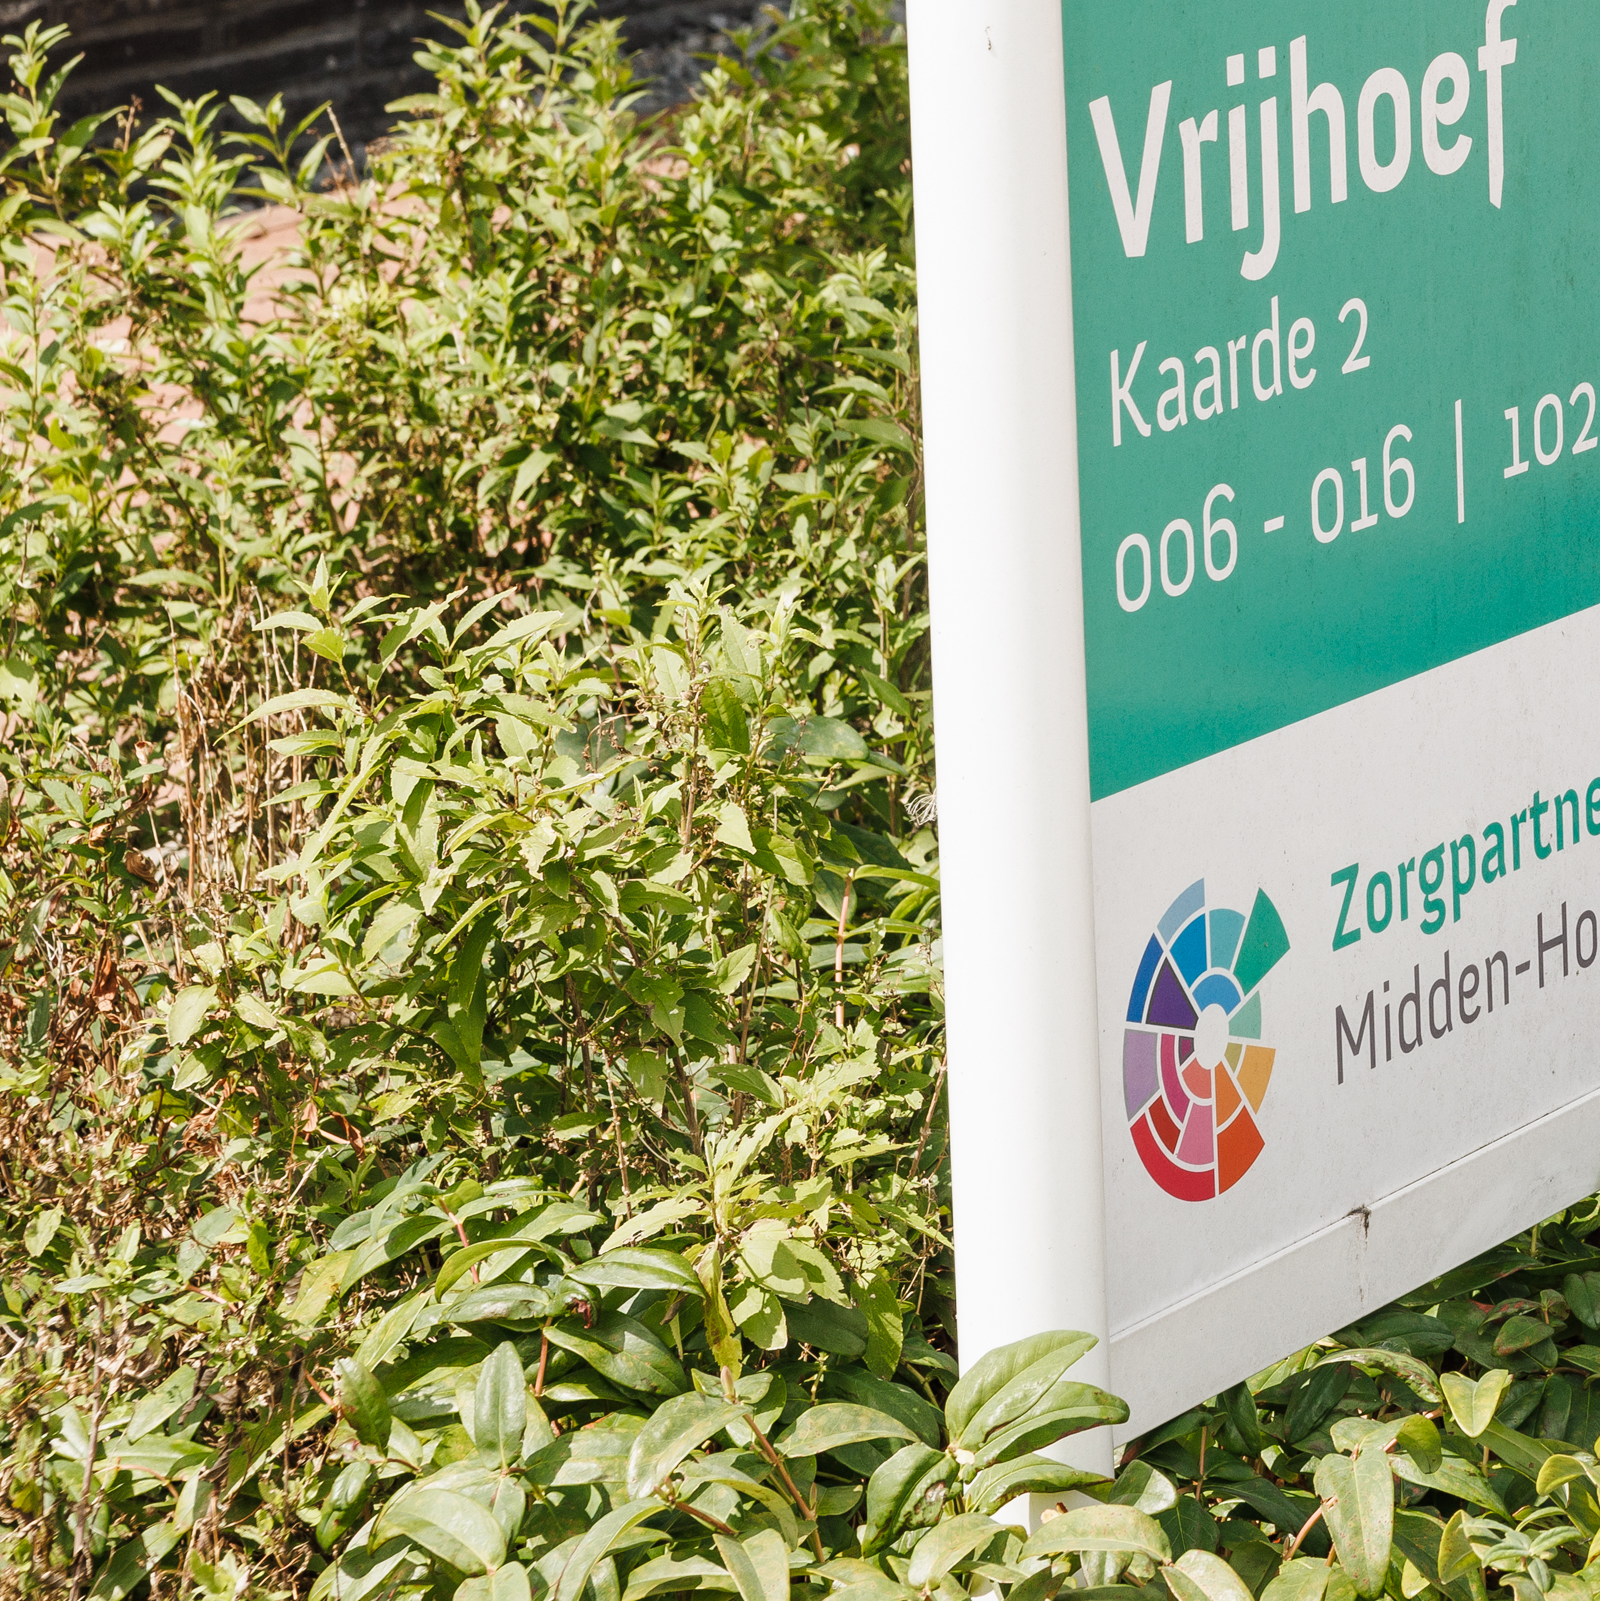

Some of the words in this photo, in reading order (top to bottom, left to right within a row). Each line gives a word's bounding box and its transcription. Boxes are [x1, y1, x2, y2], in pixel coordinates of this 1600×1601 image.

[1109, 295, 1317, 447] Kaarde
[1337, 297, 1371, 375] 2
[1115, 483, 1238, 613] 006
[1310, 423, 1415, 545] 016
[1503, 381, 1599, 479] 102
